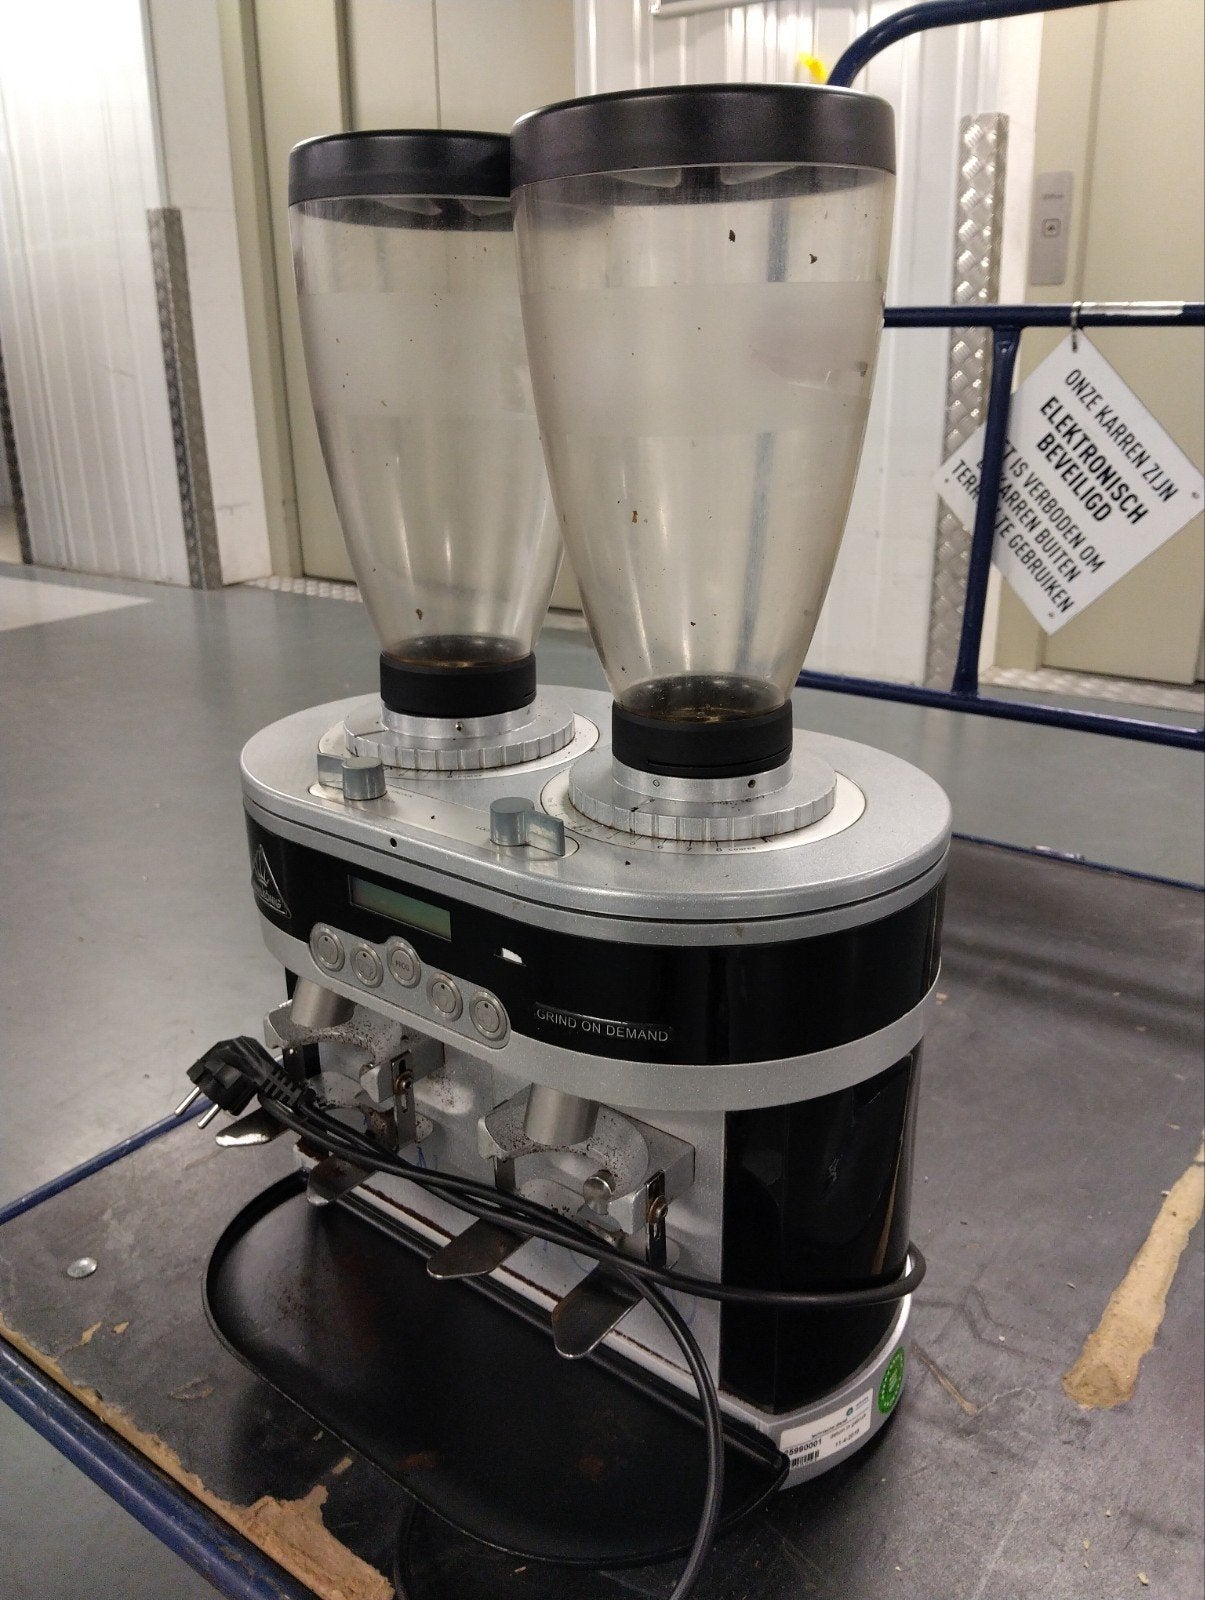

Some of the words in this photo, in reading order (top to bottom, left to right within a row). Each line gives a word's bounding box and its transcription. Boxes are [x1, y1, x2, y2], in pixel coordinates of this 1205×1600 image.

[1036, 434, 1111, 522] BEVEILIGD
[1040, 396, 1149, 524] ELEKTRONISCH
[1065, 368, 1102, 411] ONZE
[1095, 402, 1150, 472] KARREN
[1141, 461, 1178, 502] ZIJN
[994, 514, 1015, 538] TE
[1009, 534, 1075, 613] GEBRUIKEN
[1010, 456, 1029, 477] IS
[1023, 472, 1086, 549] VERBODEN
[1080, 545, 1106, 574] OM
[1035, 528, 1082, 583] BUITEN
[536, 1008, 577, 1028] GRIND
[581, 1020, 601, 1034] ON
[606, 1025, 669, 1042] DEMAND
